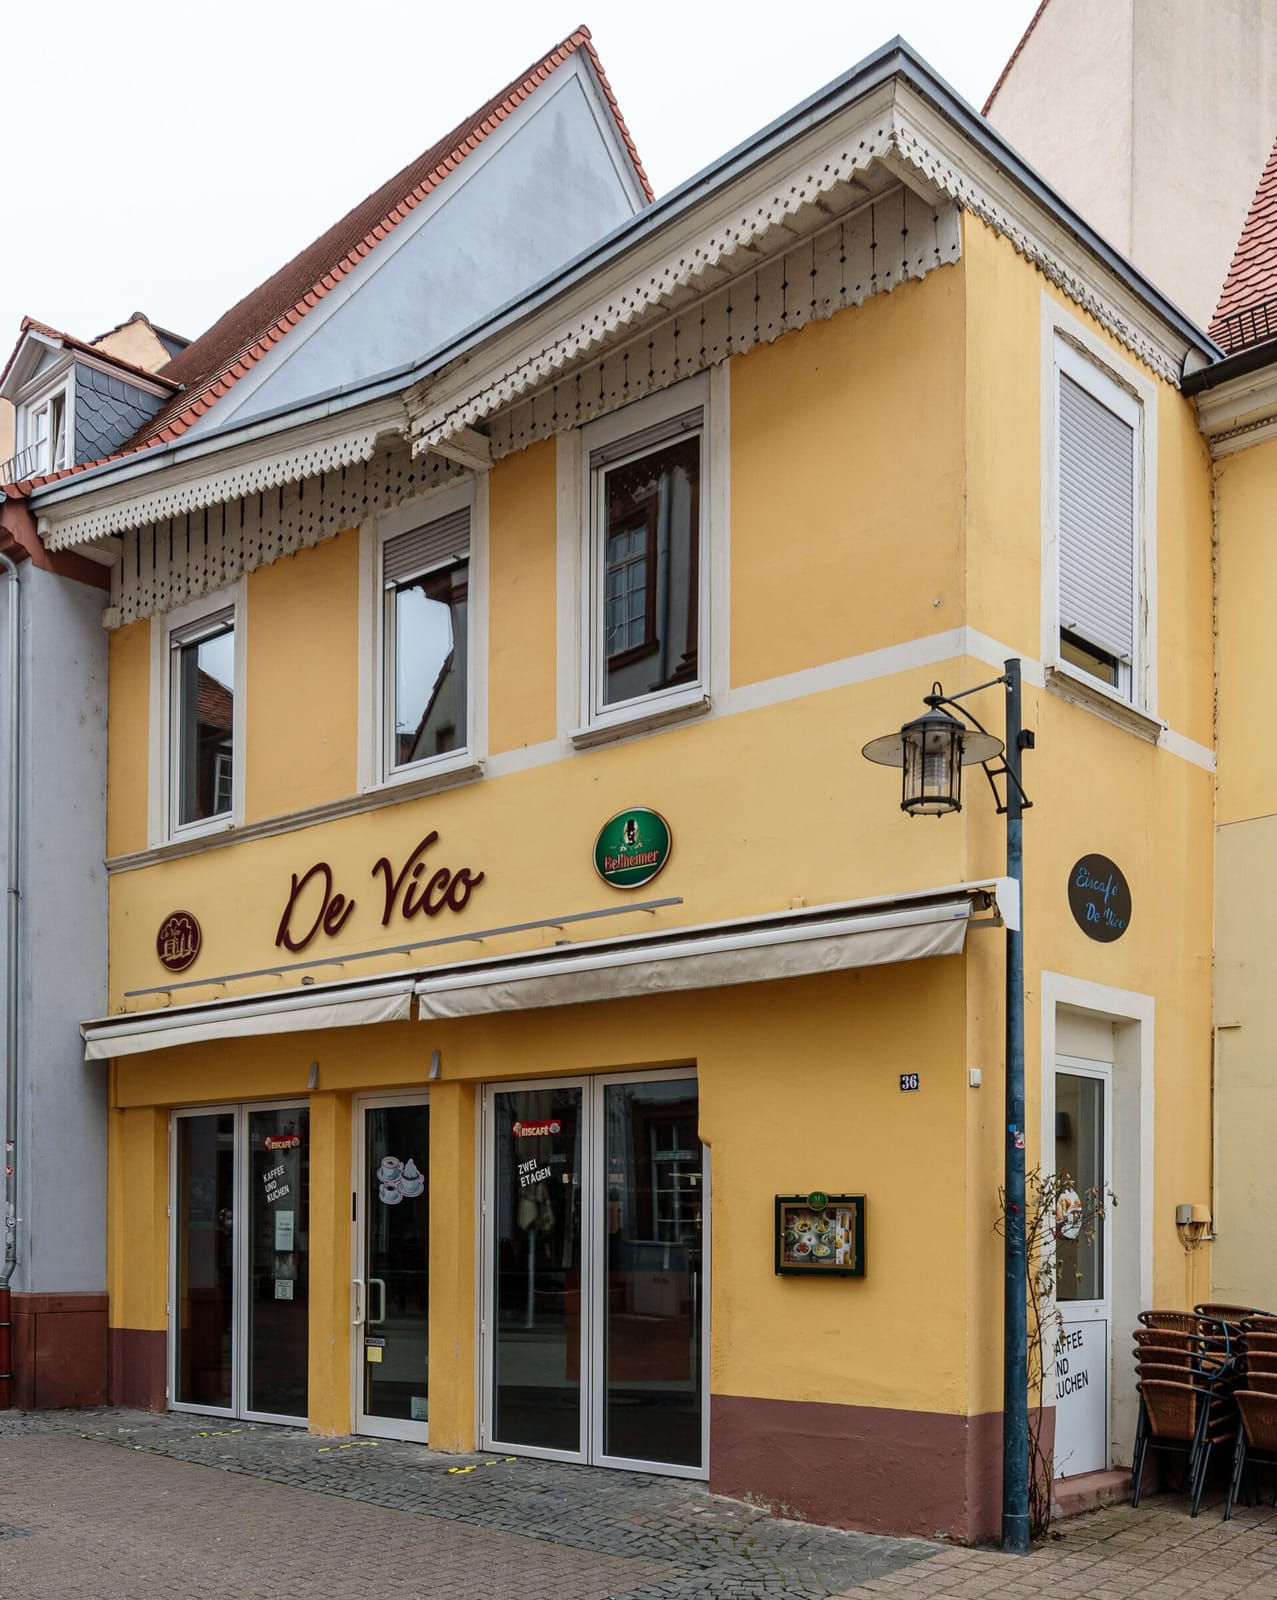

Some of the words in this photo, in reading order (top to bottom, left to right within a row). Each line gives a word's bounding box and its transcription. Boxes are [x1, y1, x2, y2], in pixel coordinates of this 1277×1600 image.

[605, 850, 659, 872] Bellheimer
[275, 862, 355, 952] De
[371, 830, 485, 926] Vico
[1085, 901, 1100, 922] De
[901, 1075, 918, 1090] 36
[521, 1125, 550, 1137] EISCAFÉ
[262, 1164, 286, 1183] KAFFEE
[518, 1158, 538, 1175] ZWEI
[264, 1180, 277, 1193] UND
[520, 1166, 552, 1188] ETAGEN
[266, 1184, 290, 1203] KUCHEN
[1055, 1329, 1084, 1357] AFFEE
[1055, 1358, 1070, 1378] ND
[1055, 1369, 1089, 1400] UCHEN
